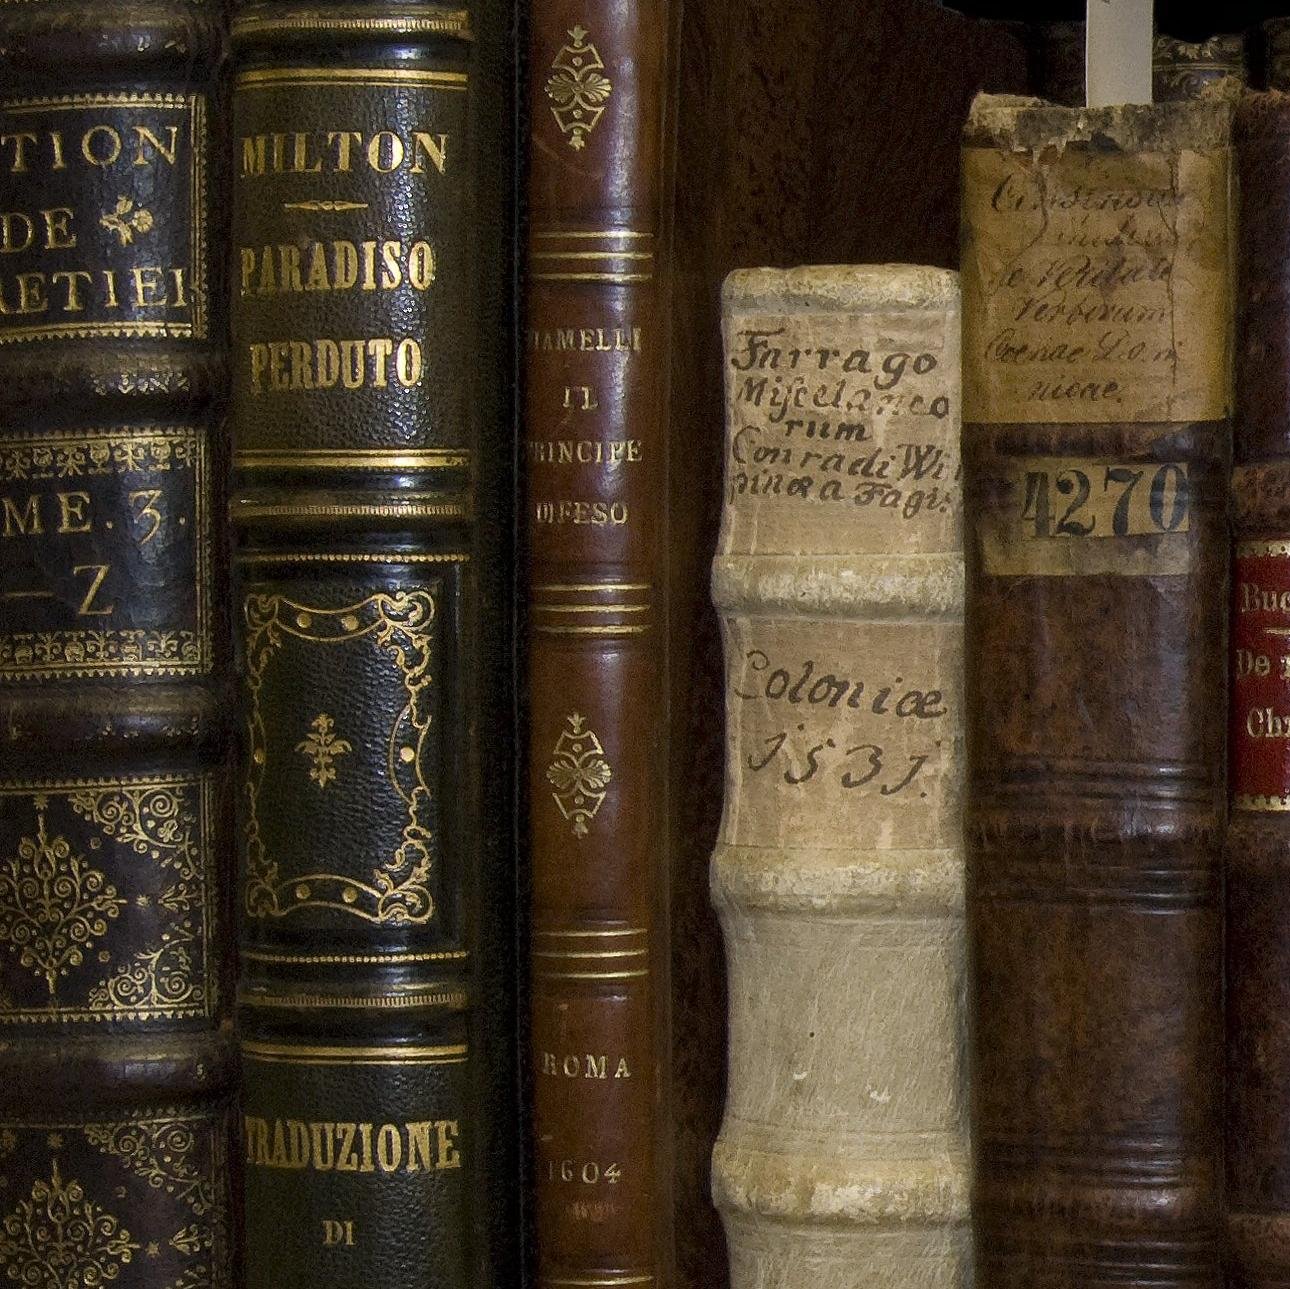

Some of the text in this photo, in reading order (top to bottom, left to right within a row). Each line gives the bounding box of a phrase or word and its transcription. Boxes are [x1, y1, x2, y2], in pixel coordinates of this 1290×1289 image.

[1, 125, 178, 172] TION
[240, 131, 449, 175] MILTON
[0, 207, 77, 254] DE
[0, 267, 187, 314] ETIEI
[240, 240, 436, 296] PARADISO
[249, 337, 423, 396] PERDUTO
[562, 386, 598, 411] IL
[536, 501, 628, 525] DIFESO
[1021, 464, 1190, 537] 4270
[73, 563, 114, 615] Z
[542, 1052, 632, 1080] ROMA
[245, 1115, 461, 1173] TRADUZIONE
[547, 1159, 622, 1184] 1604
[321, 1219, 357, 1246] DI
